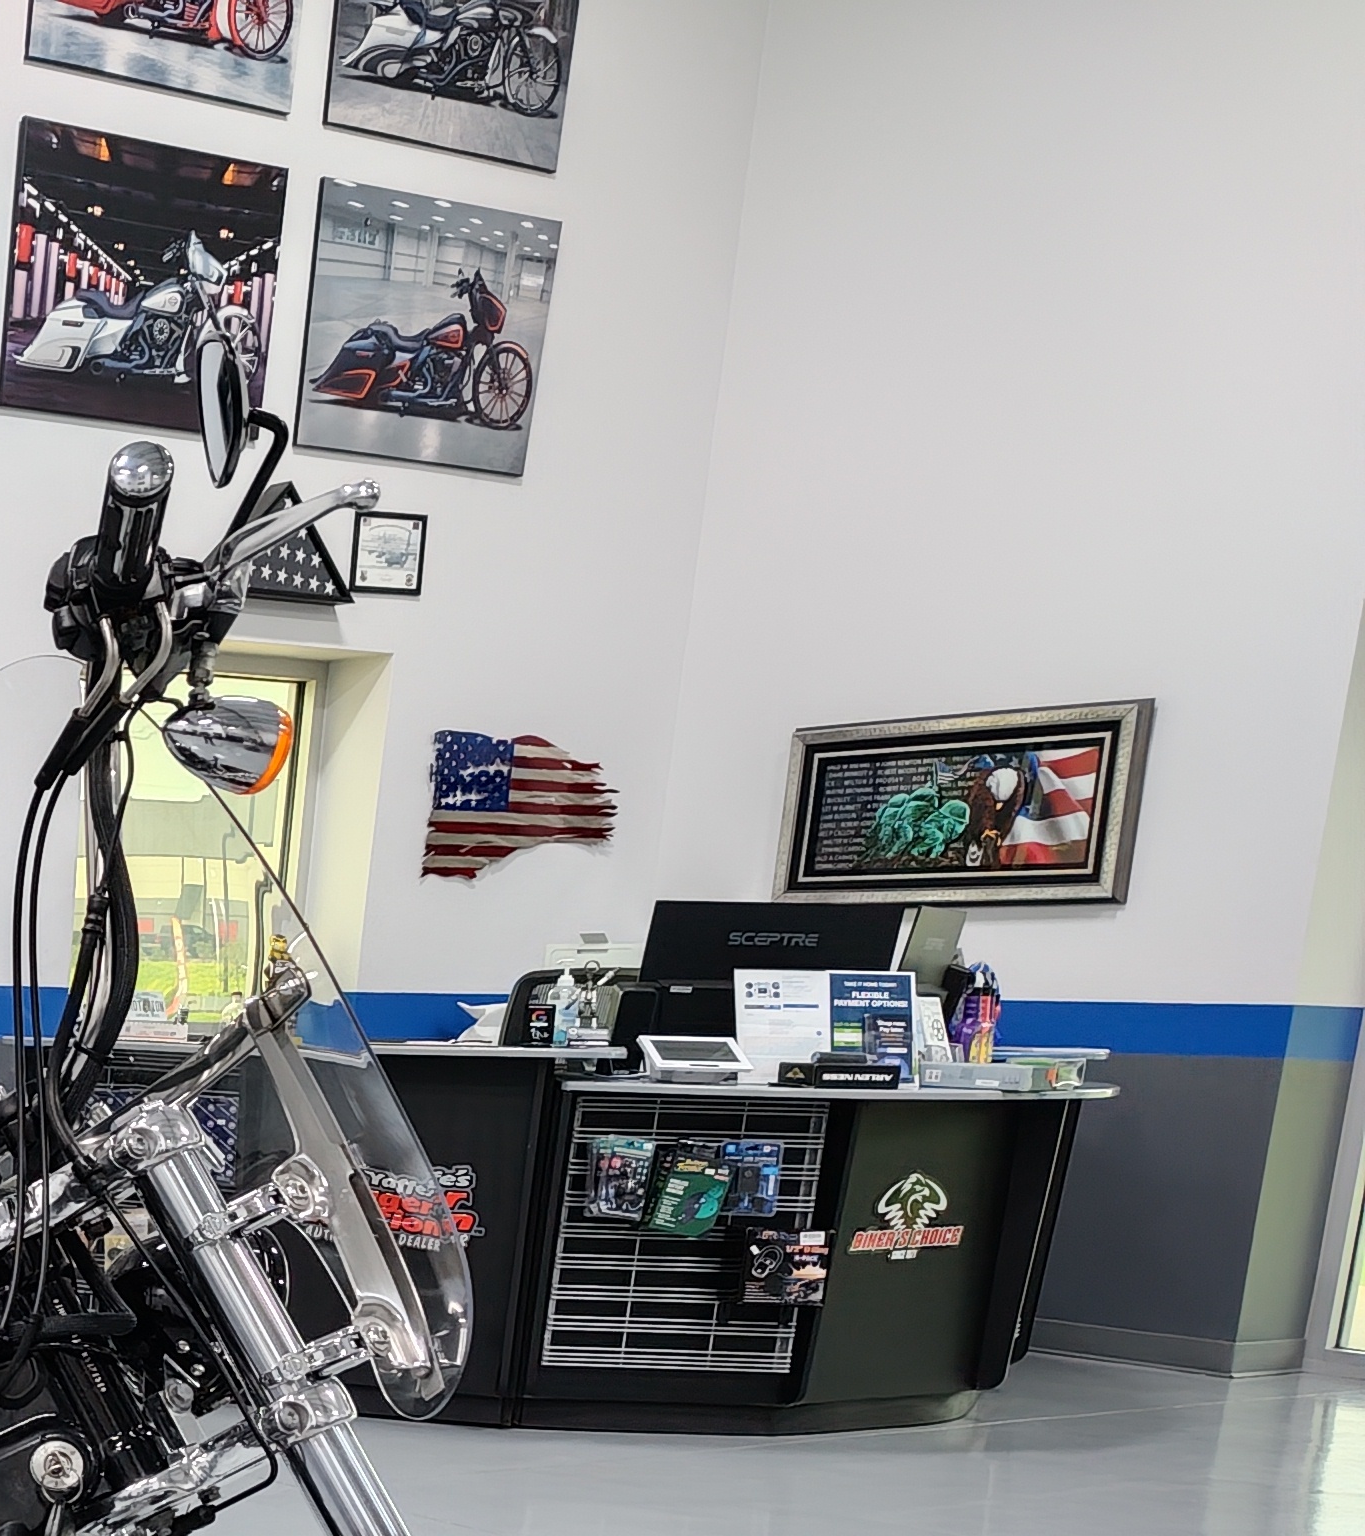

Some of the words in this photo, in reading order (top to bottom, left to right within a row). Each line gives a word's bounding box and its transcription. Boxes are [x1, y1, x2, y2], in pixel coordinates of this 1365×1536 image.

[728, 931, 820, 947] SCEPTRE
[851, 991, 890, 999] FLEXIBLE
[833, 999, 871, 1008] PAYMENT
[871, 999, 909, 1008] OPTIONS!
[399, 1233, 441, 1252] DEALER
[851, 1229, 910, 1250] BIKER'S
[909, 1226, 963, 1247] CHOICE
